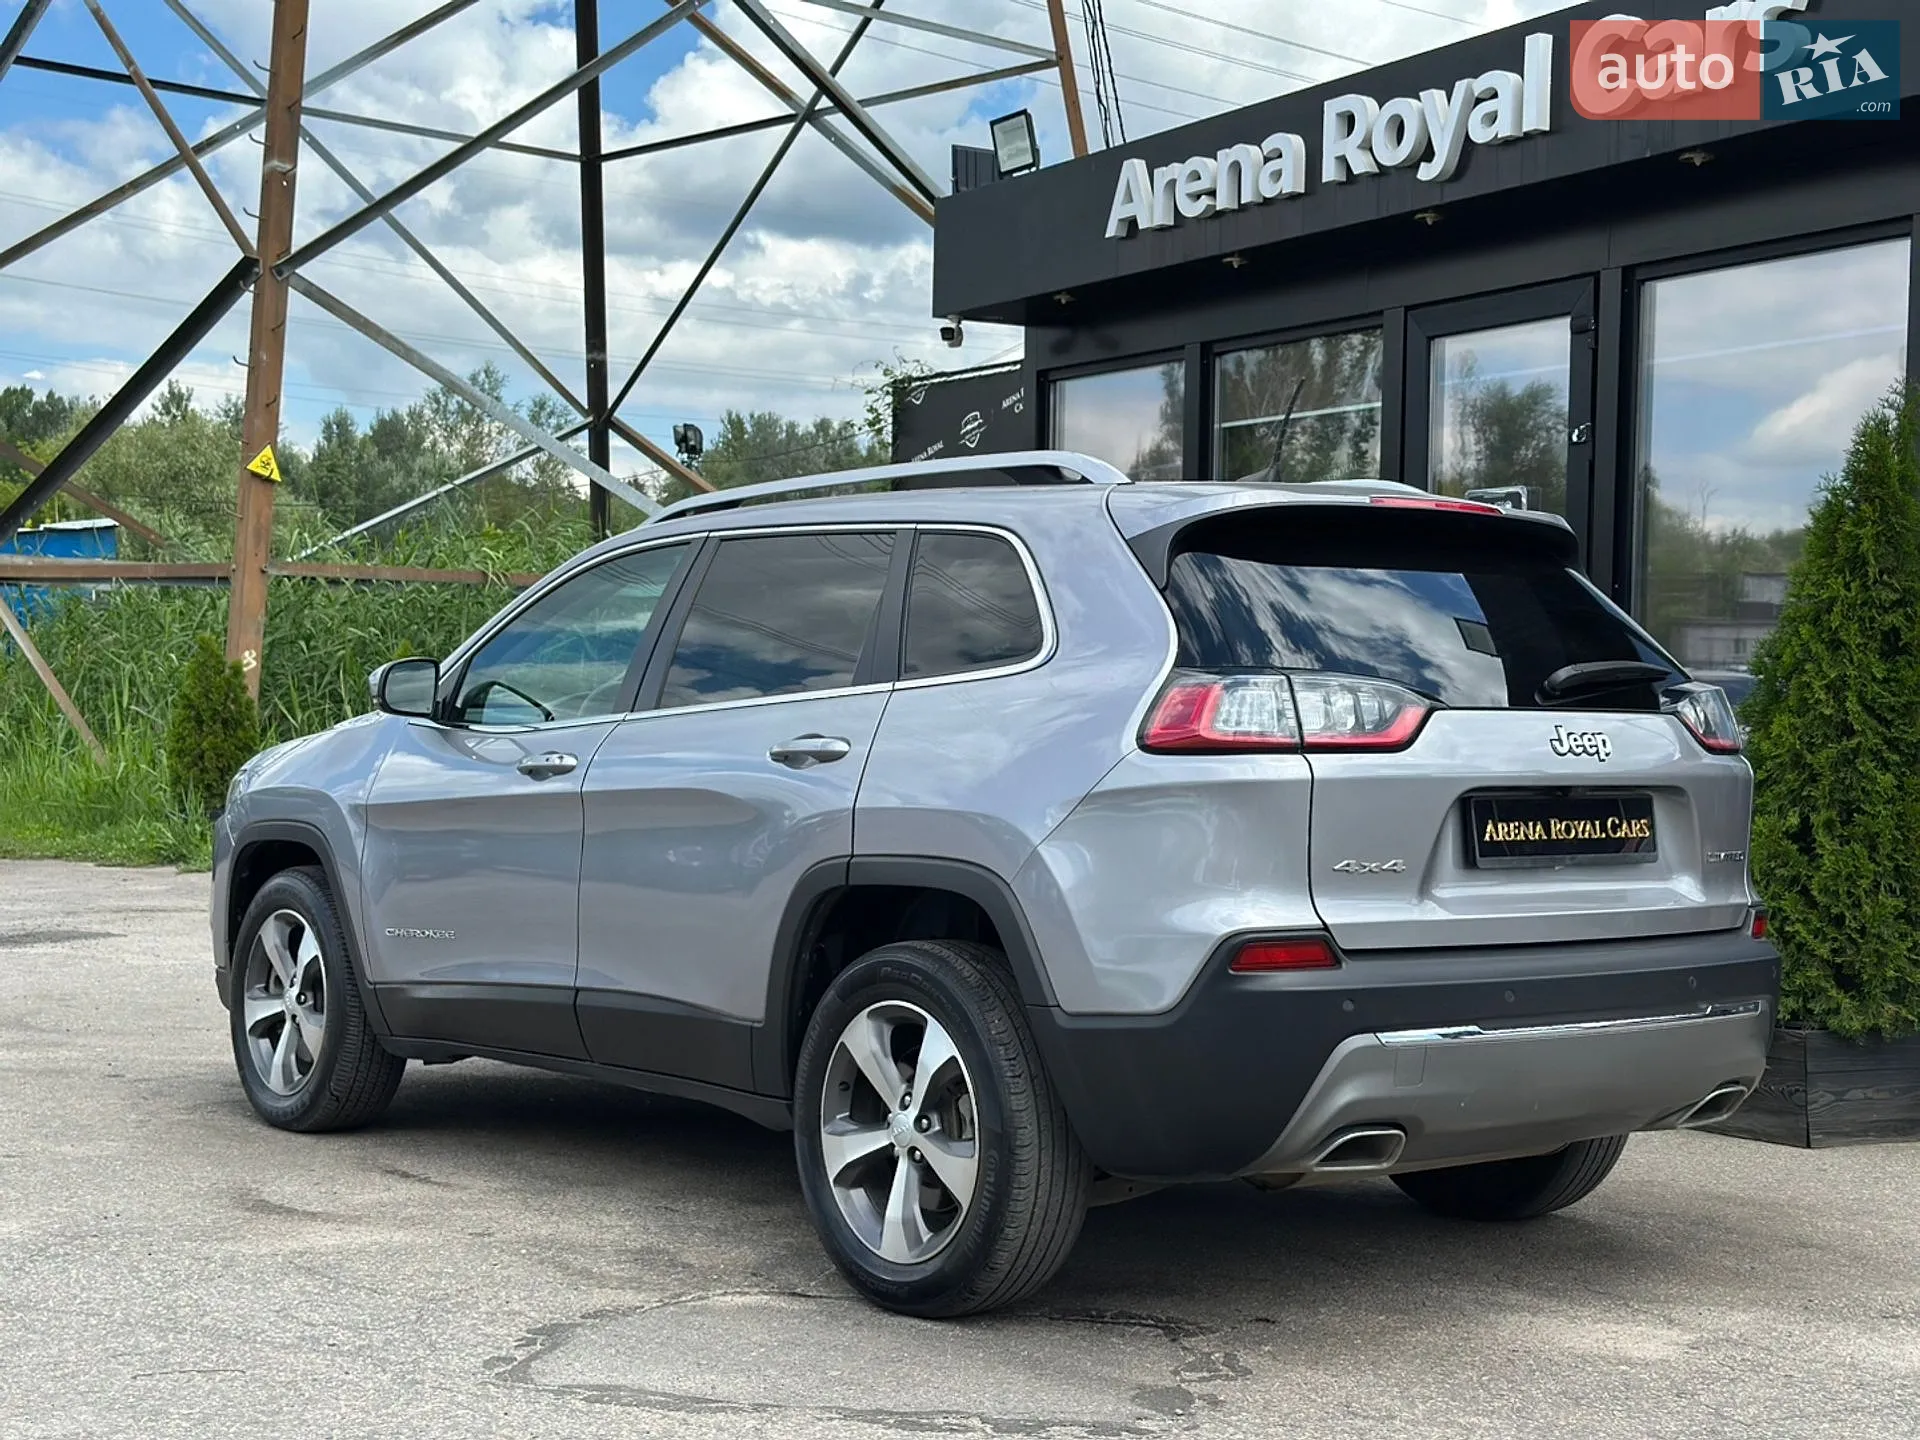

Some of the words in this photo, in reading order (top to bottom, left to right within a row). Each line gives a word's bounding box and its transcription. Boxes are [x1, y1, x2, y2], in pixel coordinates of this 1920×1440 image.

[1104, 132, 1305, 239] Arena
[1321, 32, 1553, 182] Royal
[1549, 725, 1613, 762] Jeep
[1484, 819, 1547, 842] ARENA
[1550, 817, 1606, 840] ROYAL
[1607, 816, 1650, 838] CARS
[1332, 859, 1406, 873] 4x4
[385, 927, 456, 939] CHEROKEE
